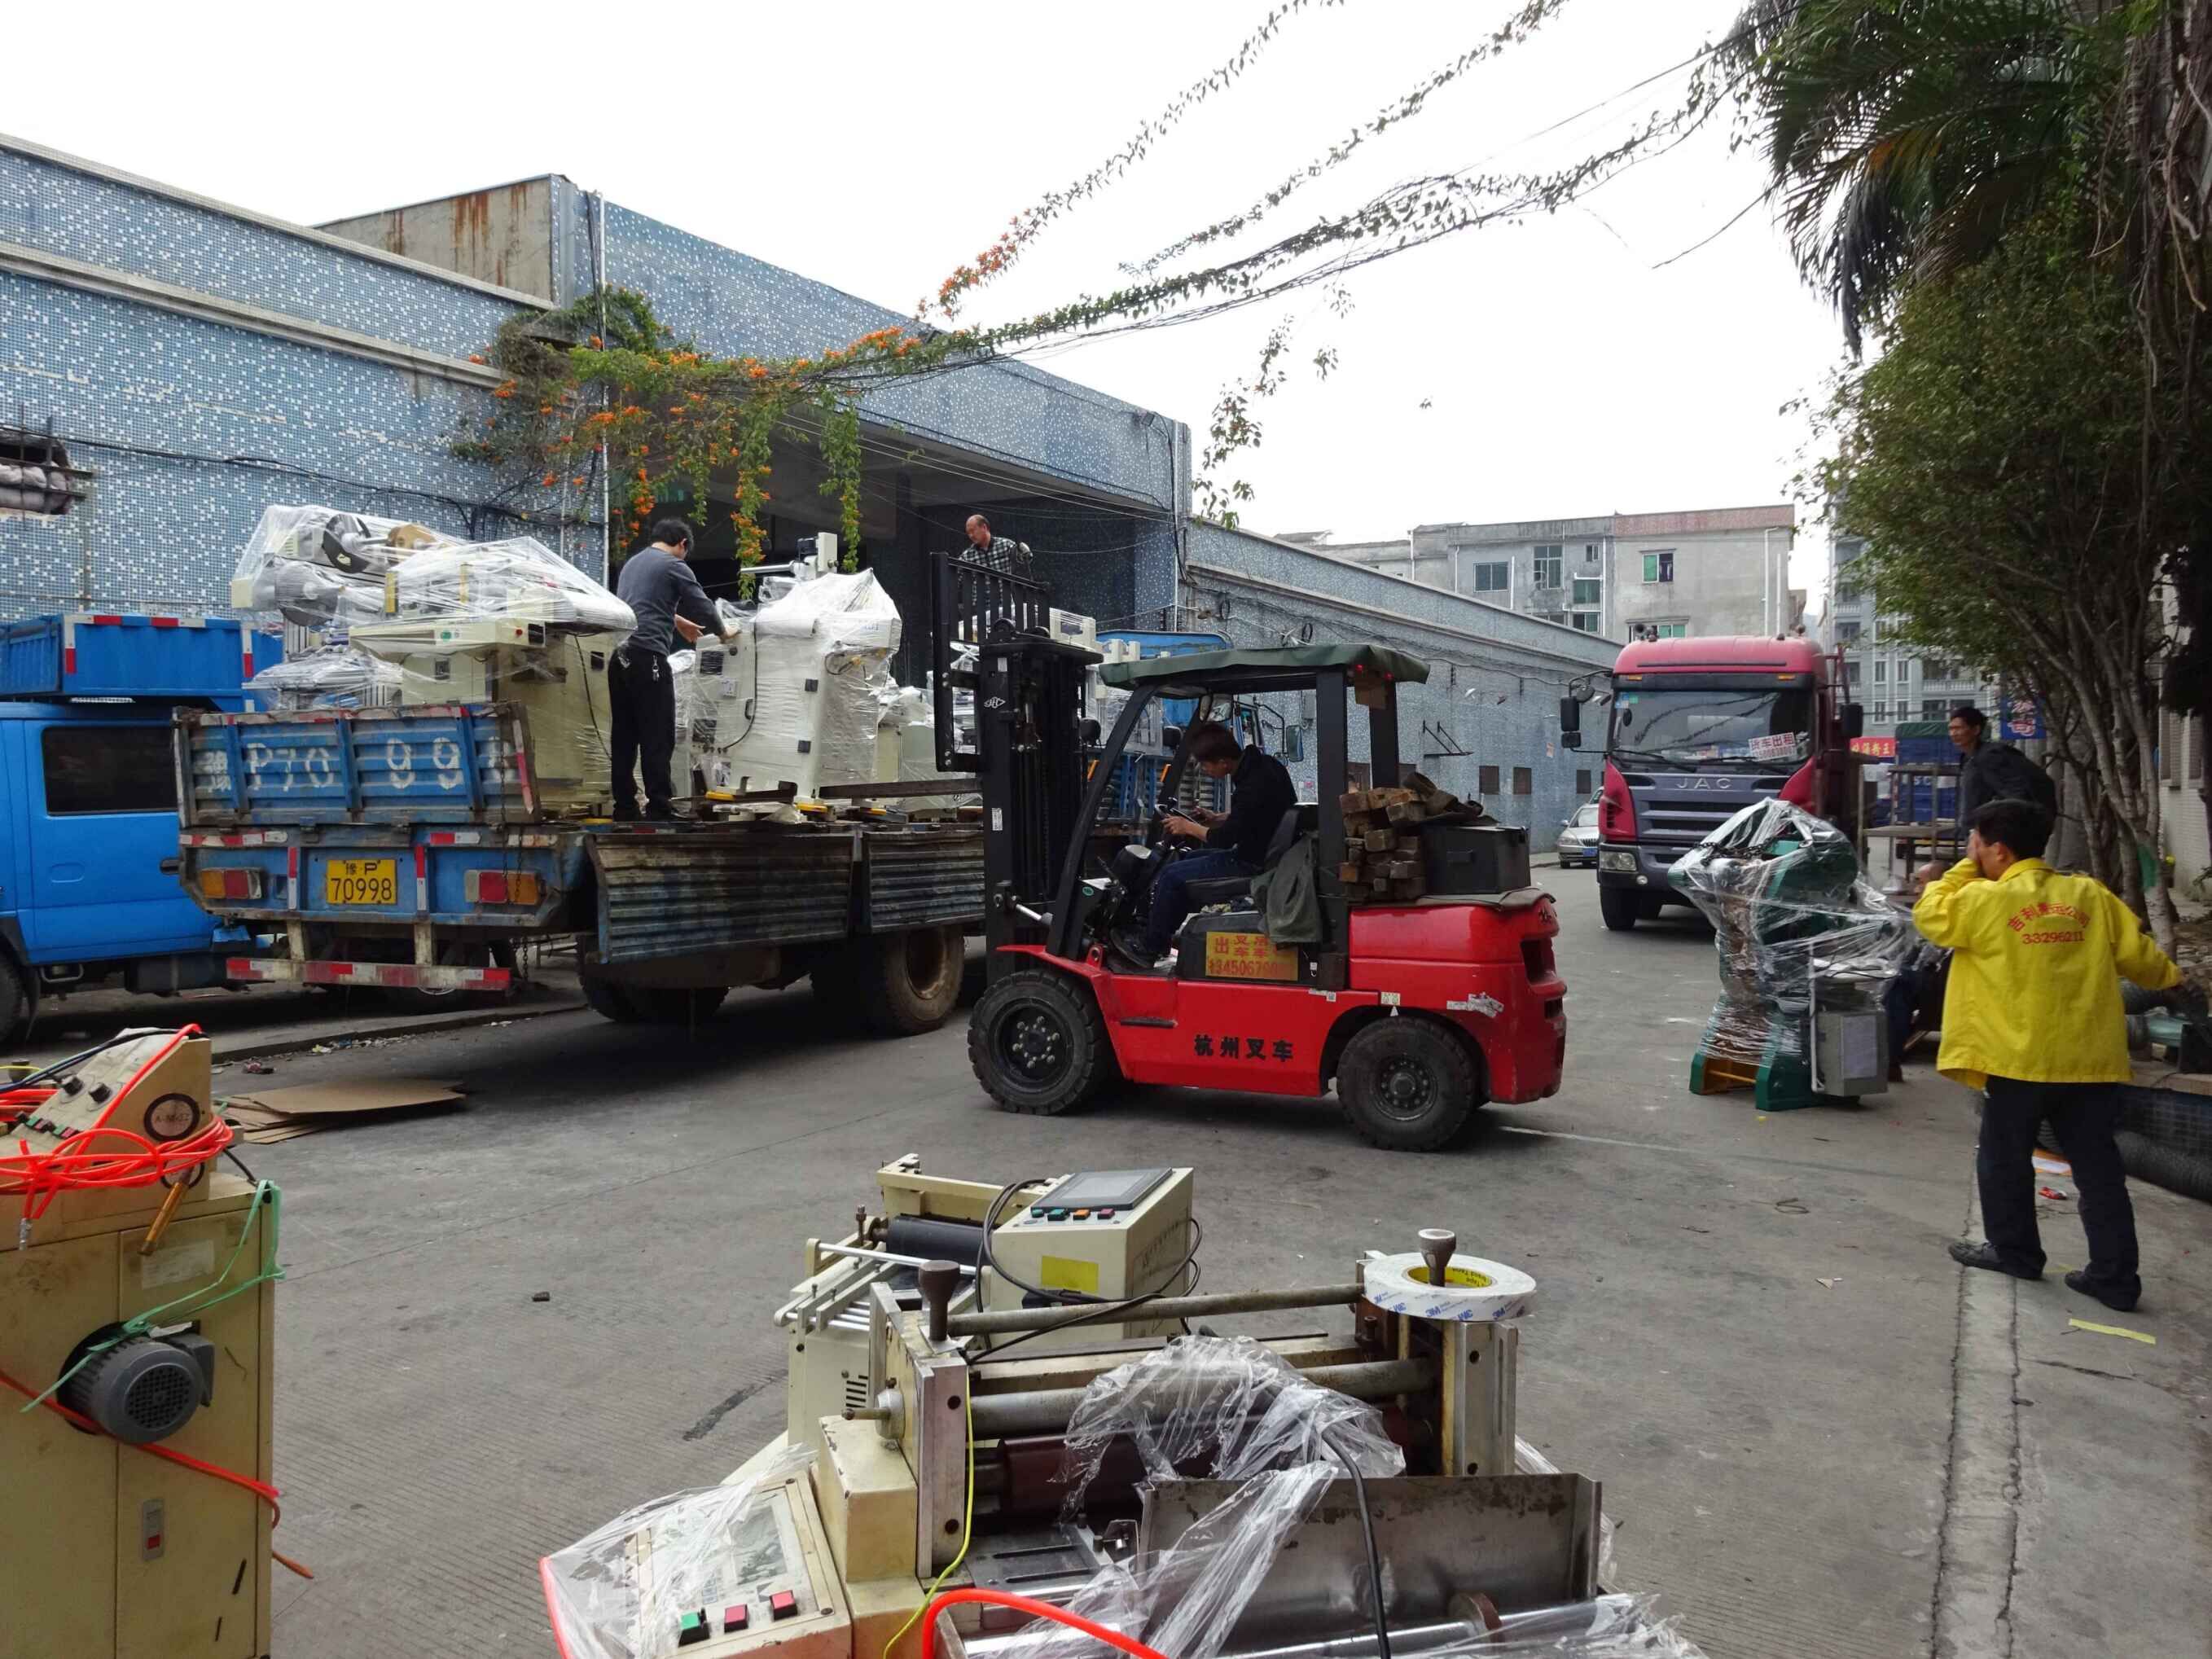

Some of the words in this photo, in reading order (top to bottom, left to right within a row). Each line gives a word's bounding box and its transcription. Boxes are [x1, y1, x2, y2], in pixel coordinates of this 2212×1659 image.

[1674, 777, 1731, 789] JAC
[331, 877, 392, 901] 70998
[1194, 1034, 1293, 1062] 杭州叉车
[1425, 1306, 1442, 1317] 3M
